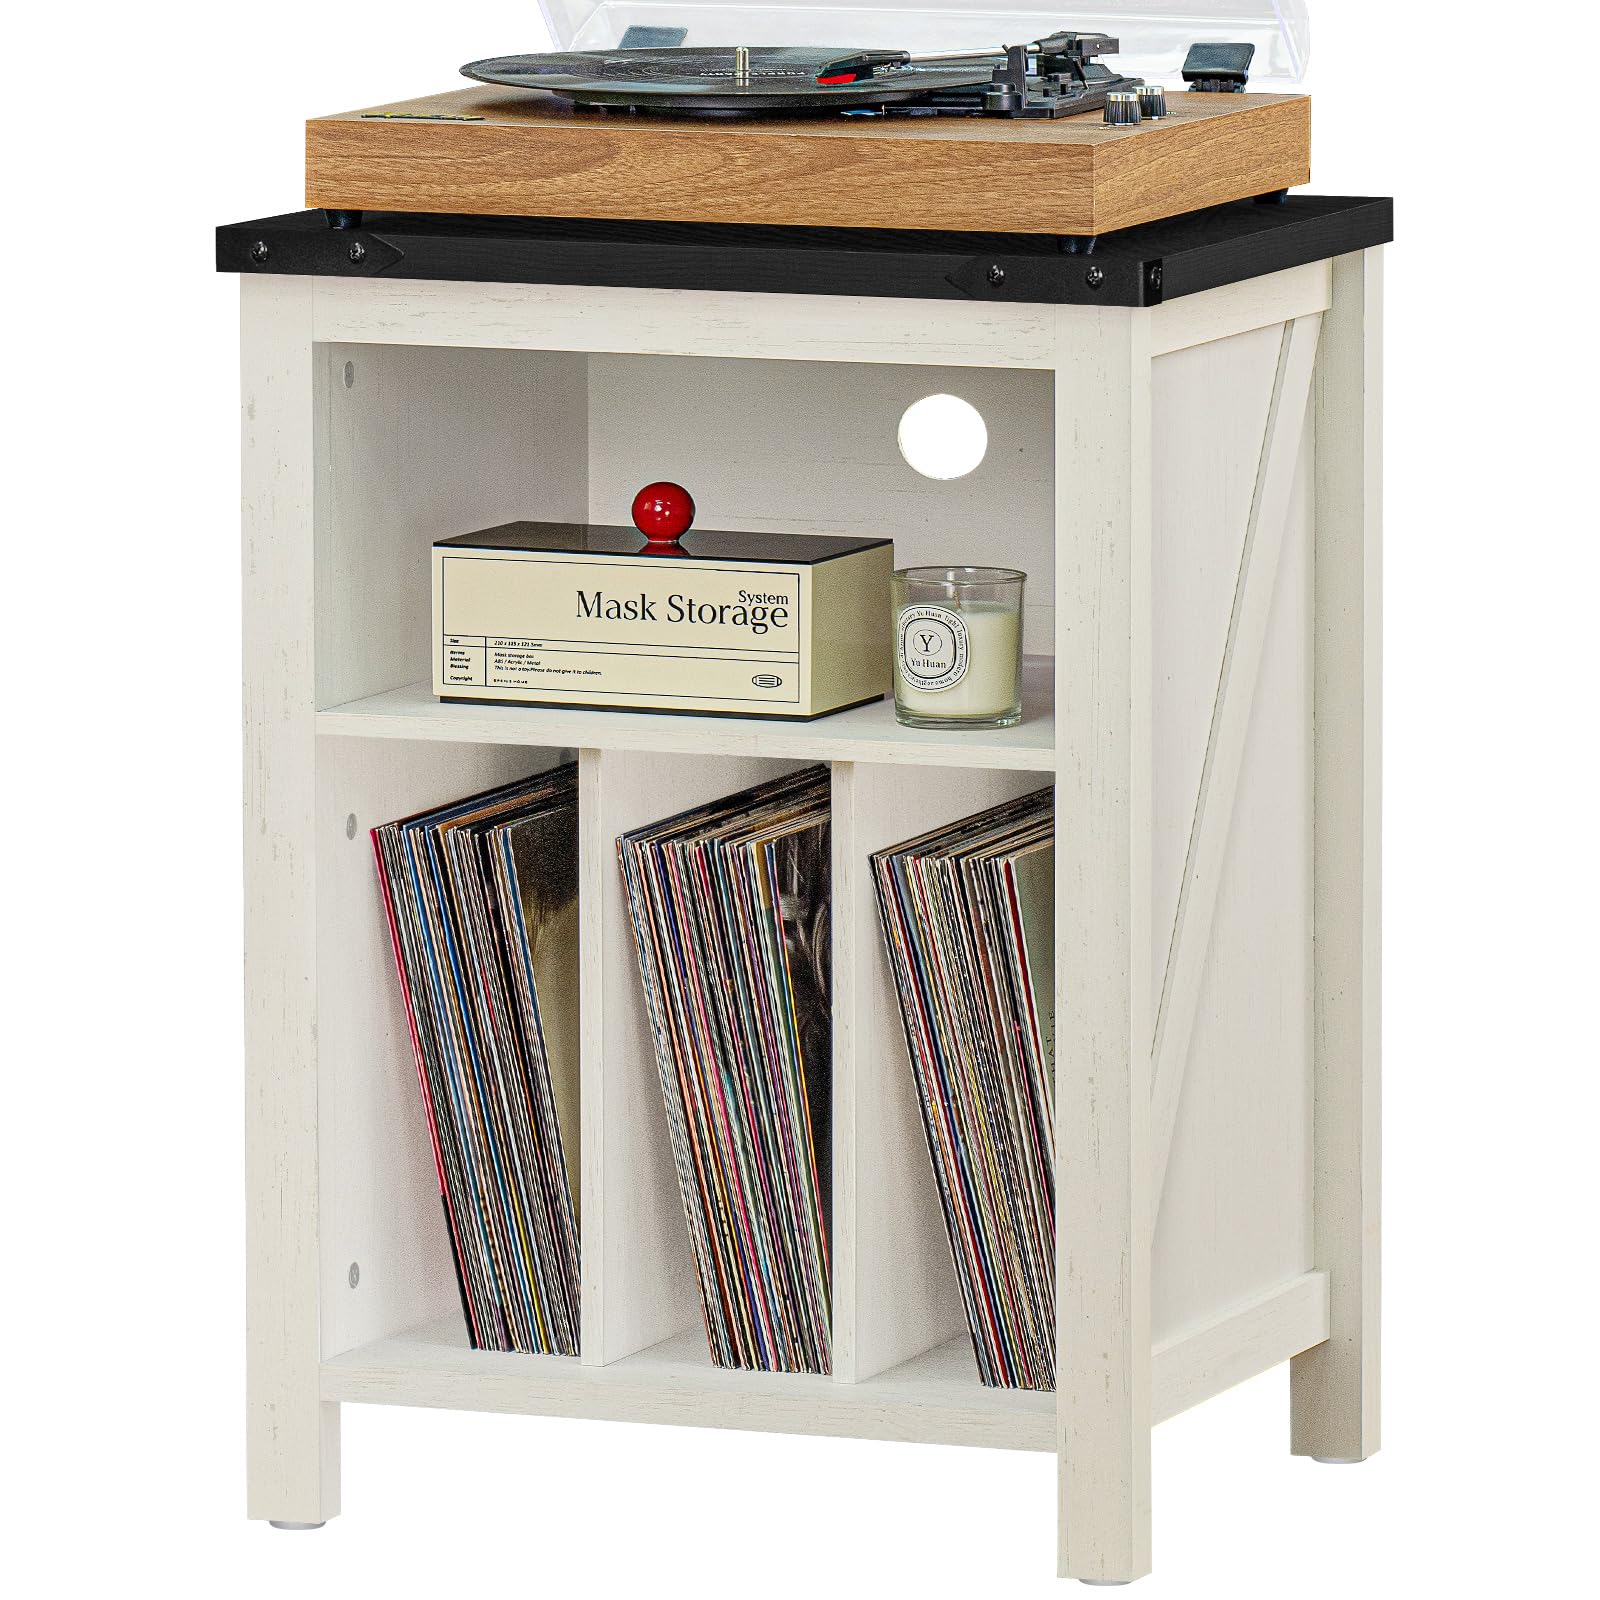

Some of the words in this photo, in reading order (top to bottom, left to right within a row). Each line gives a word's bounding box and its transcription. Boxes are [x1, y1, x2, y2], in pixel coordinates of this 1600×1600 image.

[738, 590, 789, 606] System
[576, 590, 657, 621] Mask
[667, 594, 789, 635] Storage
[920, 634, 934, 652] Y
[923, 659, 946, 669] Huan
